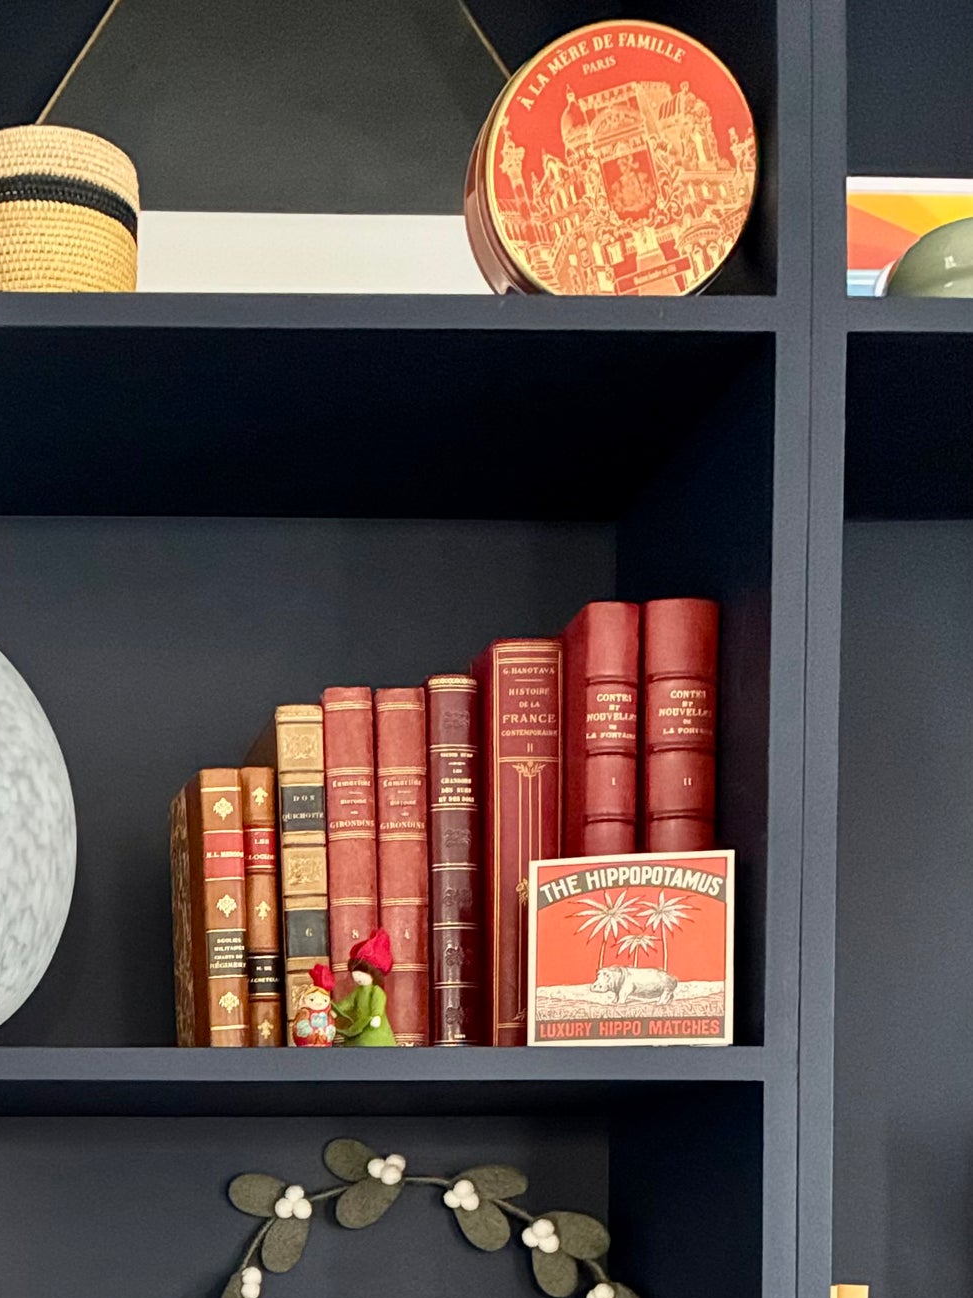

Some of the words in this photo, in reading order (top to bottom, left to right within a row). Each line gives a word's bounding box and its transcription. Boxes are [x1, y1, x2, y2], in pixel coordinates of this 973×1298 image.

[530, 74, 550, 98] LA
[548, 40, 590, 75] MÈRE
[592, 35, 614, 52] DE
[617, 31, 688, 65] FAMILLE
[582, 56, 617, 76] PARIS
[508, 687, 550, 696] HISTOIRE
[519, 701, 529, 709] DE
[502, 714, 557, 724] FRANCE
[282, 811, 324, 822] QUICHOTTE
[329, 820, 374, 830] GIRONDINS
[380, 821, 425, 830] GIRONDINS
[539, 874, 582, 904] THE
[584, 865, 725, 898] HIPPOPOTAMUS
[305, 928, 313, 937] 6
[352, 929, 359, 939] 8
[539, 1021, 593, 1038] LUXURY
[598, 1019, 642, 1037] HIPPO
[648, 1018, 721, 1036] MATCHES
